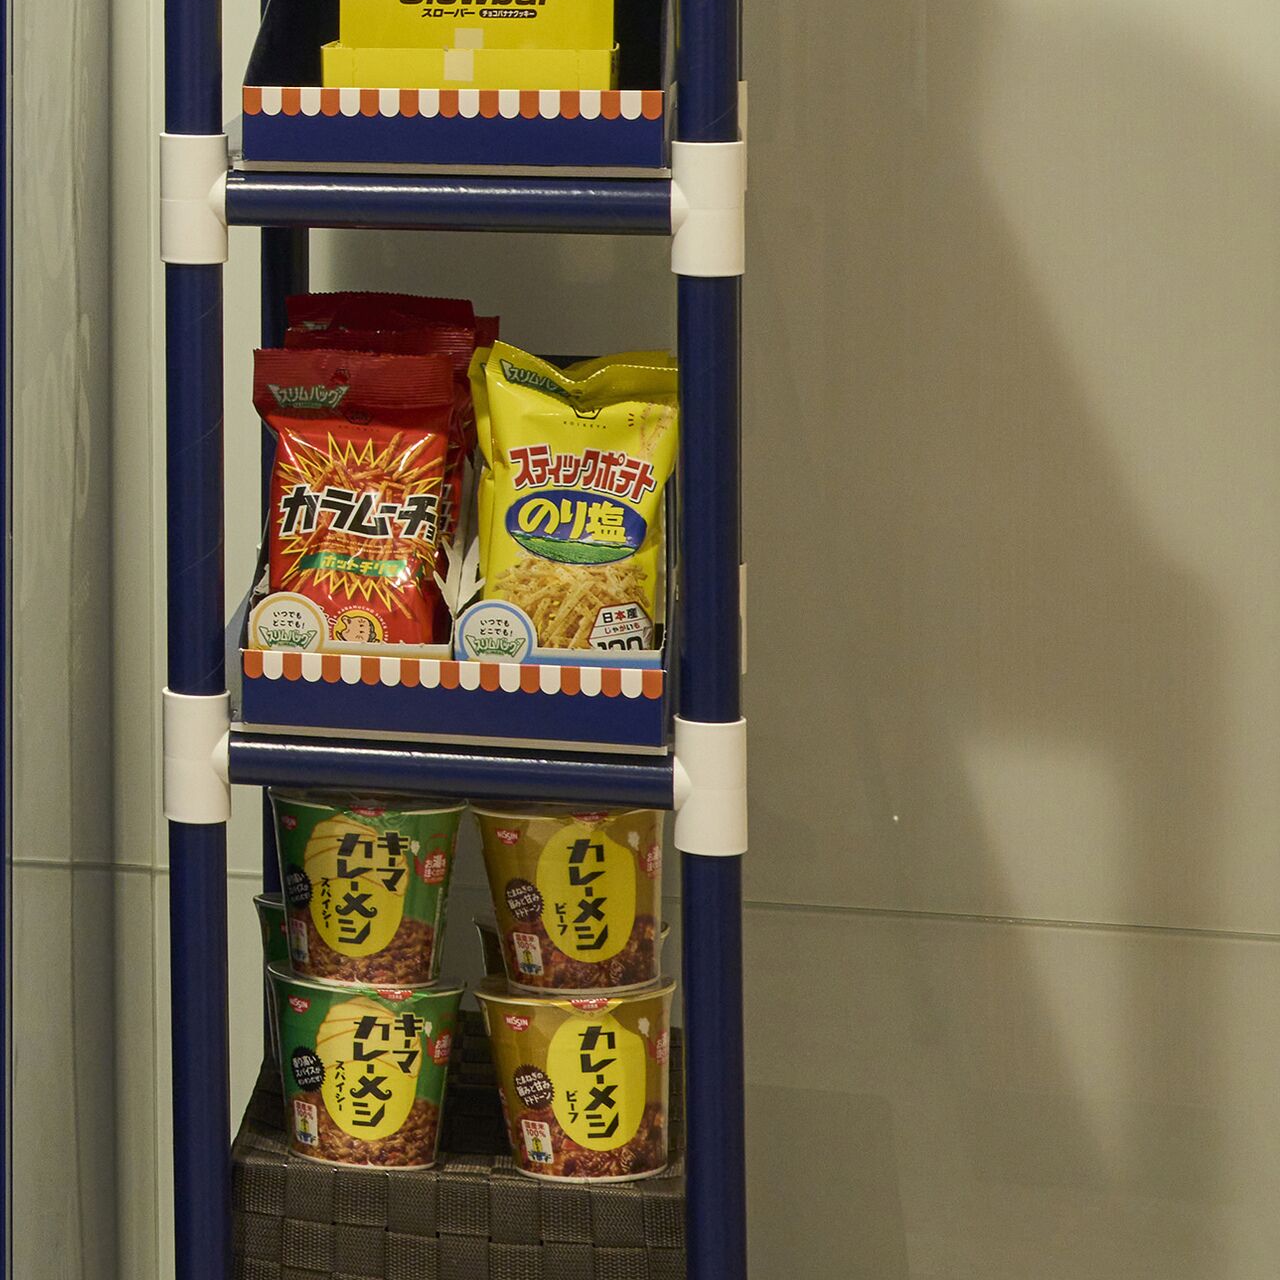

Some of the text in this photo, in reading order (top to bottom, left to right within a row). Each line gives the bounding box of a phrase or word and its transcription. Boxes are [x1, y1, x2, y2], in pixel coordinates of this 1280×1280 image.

[421, 9, 475, 18] スローバー
[509, 444, 657, 502] スティックポテト
[279, 484, 438, 544] カラムーチョ
[517, 497, 628, 544] のり塩
[273, 611, 302, 619] いつでも
[602, 609, 639, 624] 日本産
[604, 622, 641, 635] じゃがいも
[377, 831, 409, 892] キーマ
[336, 832, 378, 945] カレーメシ
